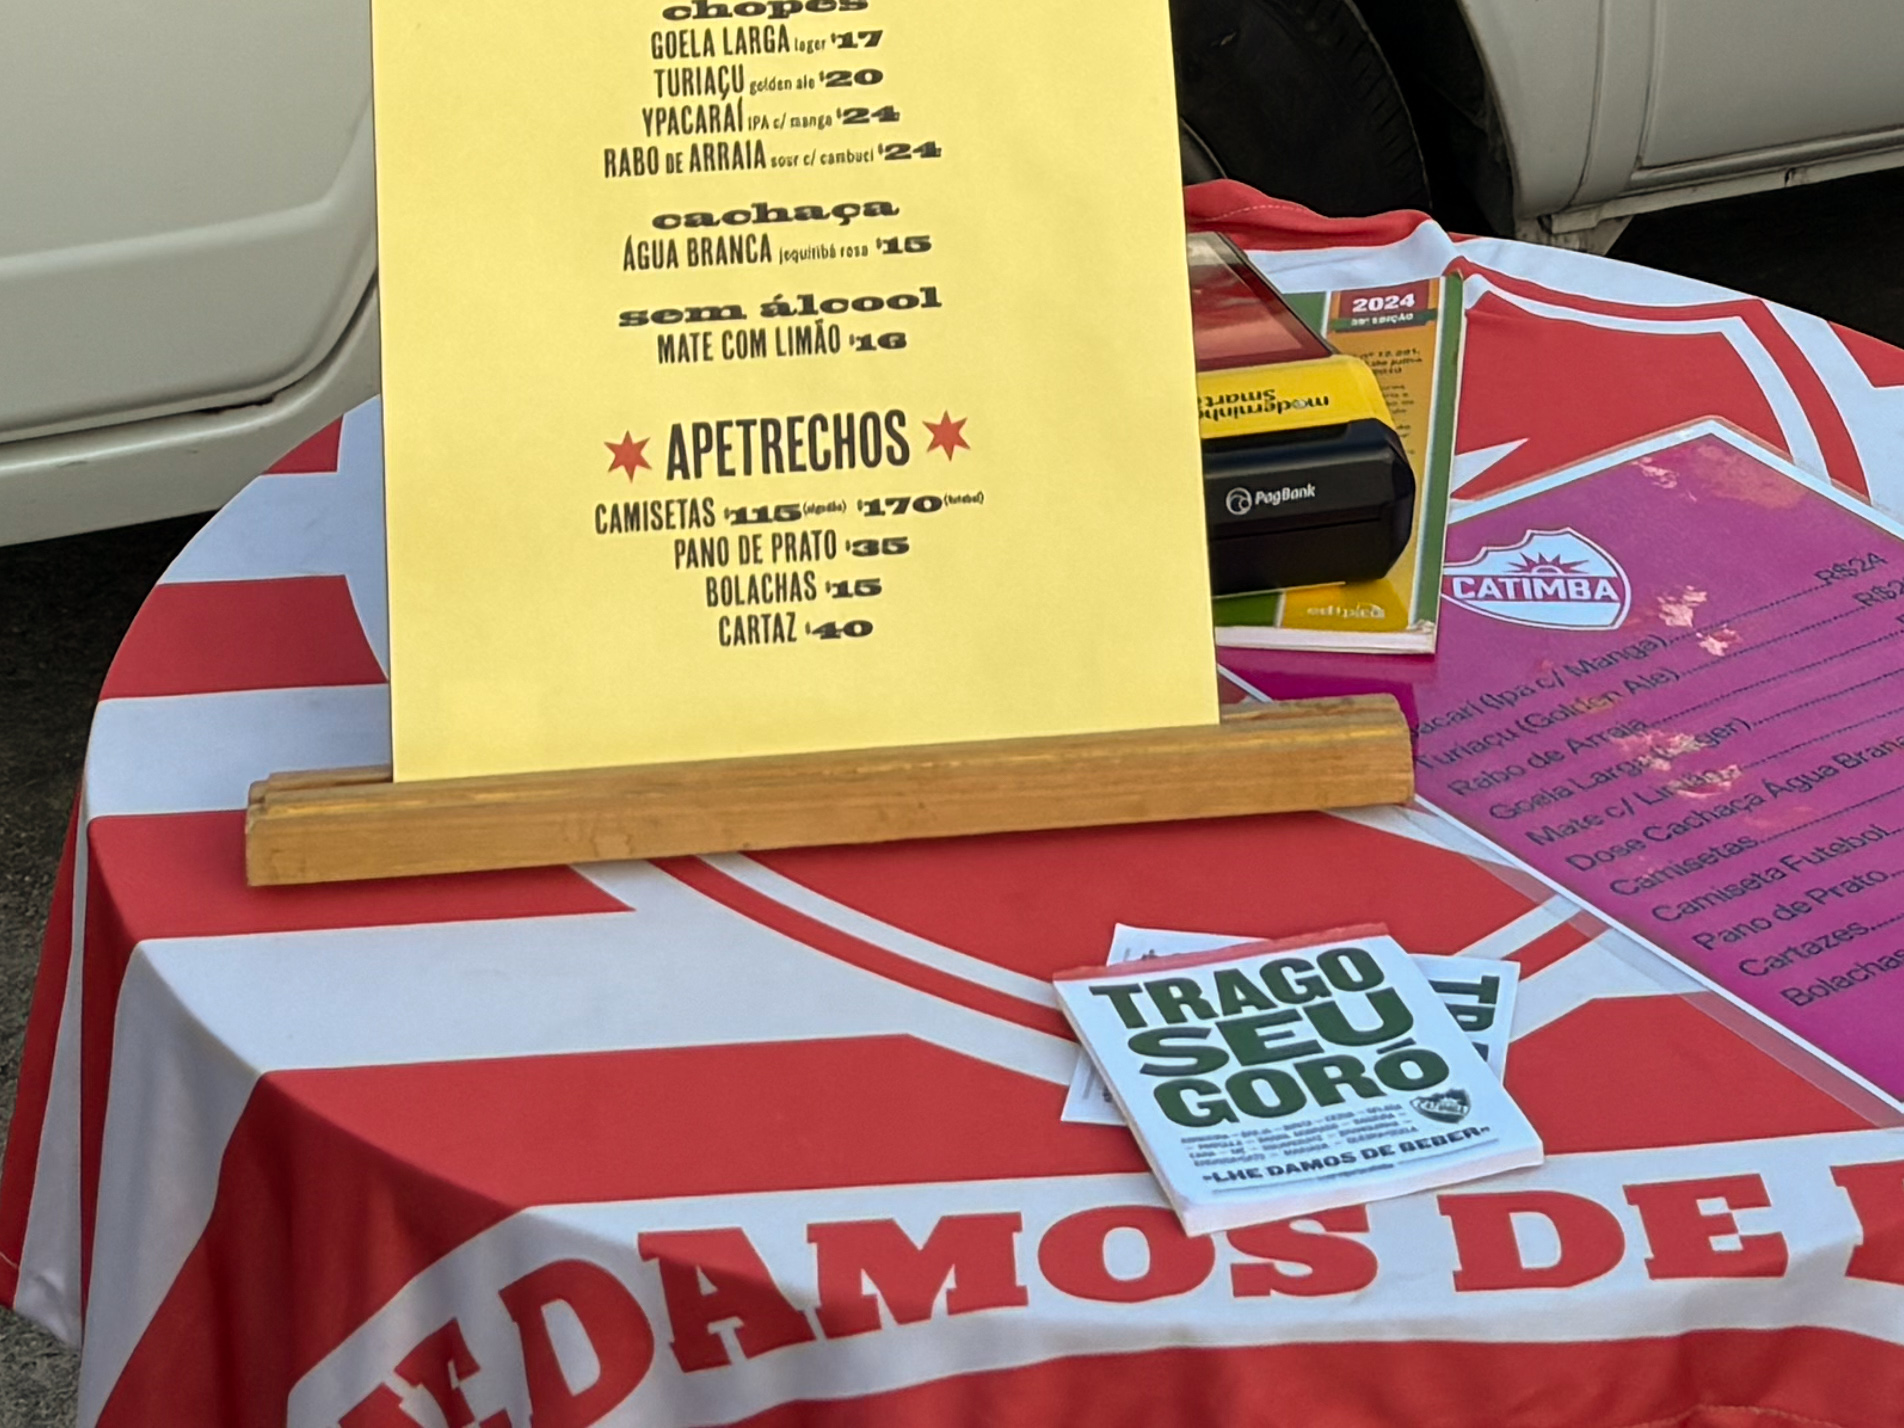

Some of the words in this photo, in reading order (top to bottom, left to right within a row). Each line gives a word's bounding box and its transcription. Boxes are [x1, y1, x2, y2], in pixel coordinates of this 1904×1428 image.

[651, 27, 715, 60] GOELA
[723, 24, 790, 56] LARGA
[654, 64, 744, 101] TURIAÇU
[750, 75, 792, 95] golden
[796, 74, 815, 90] ale
[642, 97, 744, 137] YPACARAÍ
[748, 115, 769, 131] IPA
[773, 112, 787, 130] c/
[790, 114, 833, 131] manga
[604, 146, 659, 178] RABO
[665, 153, 683, 174] DE
[689, 139, 767, 173] ARRAIA
[803, 151, 816, 167] c/
[820, 149, 874, 164] cambuci
[652, 199, 900, 231] cachaça
[623, 234, 679, 272] ÁGUA
[687, 233, 772, 268] BRANCA
[619, 303, 747, 327] sem
[760, 286, 942, 317] álcool
[1352, 292, 1416, 313] 2024
[657, 331, 713, 365] MATE
[722, 328, 767, 360] COM
[775, 318, 841, 357] LIMÃO
[665, 408, 912, 481] APETRECHOS
[1255, 483, 1316, 507] PagBank
[595, 496, 716, 535] CAMISETAS
[674, 537, 729, 570] PANO
[738, 534, 763, 566] DE
[772, 529, 837, 563] PRATO
[1813, 551, 1889, 586] R$24
[706, 571, 817, 608] BOLACHAS
[1452, 576, 1620, 602] CATIMBA
[718, 612, 797, 648] CARTAZ
[1448, 757, 1526, 798] Rabo
[1528, 742, 1566, 770] de
[1567, 716, 1648, 757] Arraia
[1488, 784, 1576, 822] Goela
[1525, 813, 1605, 847] Mate
[1606, 796, 1637, 819] c/
[1565, 835, 1648, 873] Dose
[1642, 791, 1767, 843] Cachaça
[1764, 762, 1838, 800] Água
[1609, 835, 1760, 897] Camisetas
[1651, 862, 1788, 923] Camiseta
[1783, 823, 1890, 872] Futebol
[1691, 914, 1773, 952] Pano
[1775, 894, 1813, 922] de
[1809, 867, 1890, 907] Prato
[1738, 919, 1872, 978] Cartazes
[1088, 946, 1386, 1030] TRAGO
[1127, 987, 1415, 1078] SEU
[1153, 1037, 1450, 1129] GORÓ
[1267, 1151, 1358, 1177] DAMOS
[1363, 1141, 1397, 1161] DE
[499, 1206, 1379, 1428] DAMOS
[1447, 1181, 1790, 1294] DE
